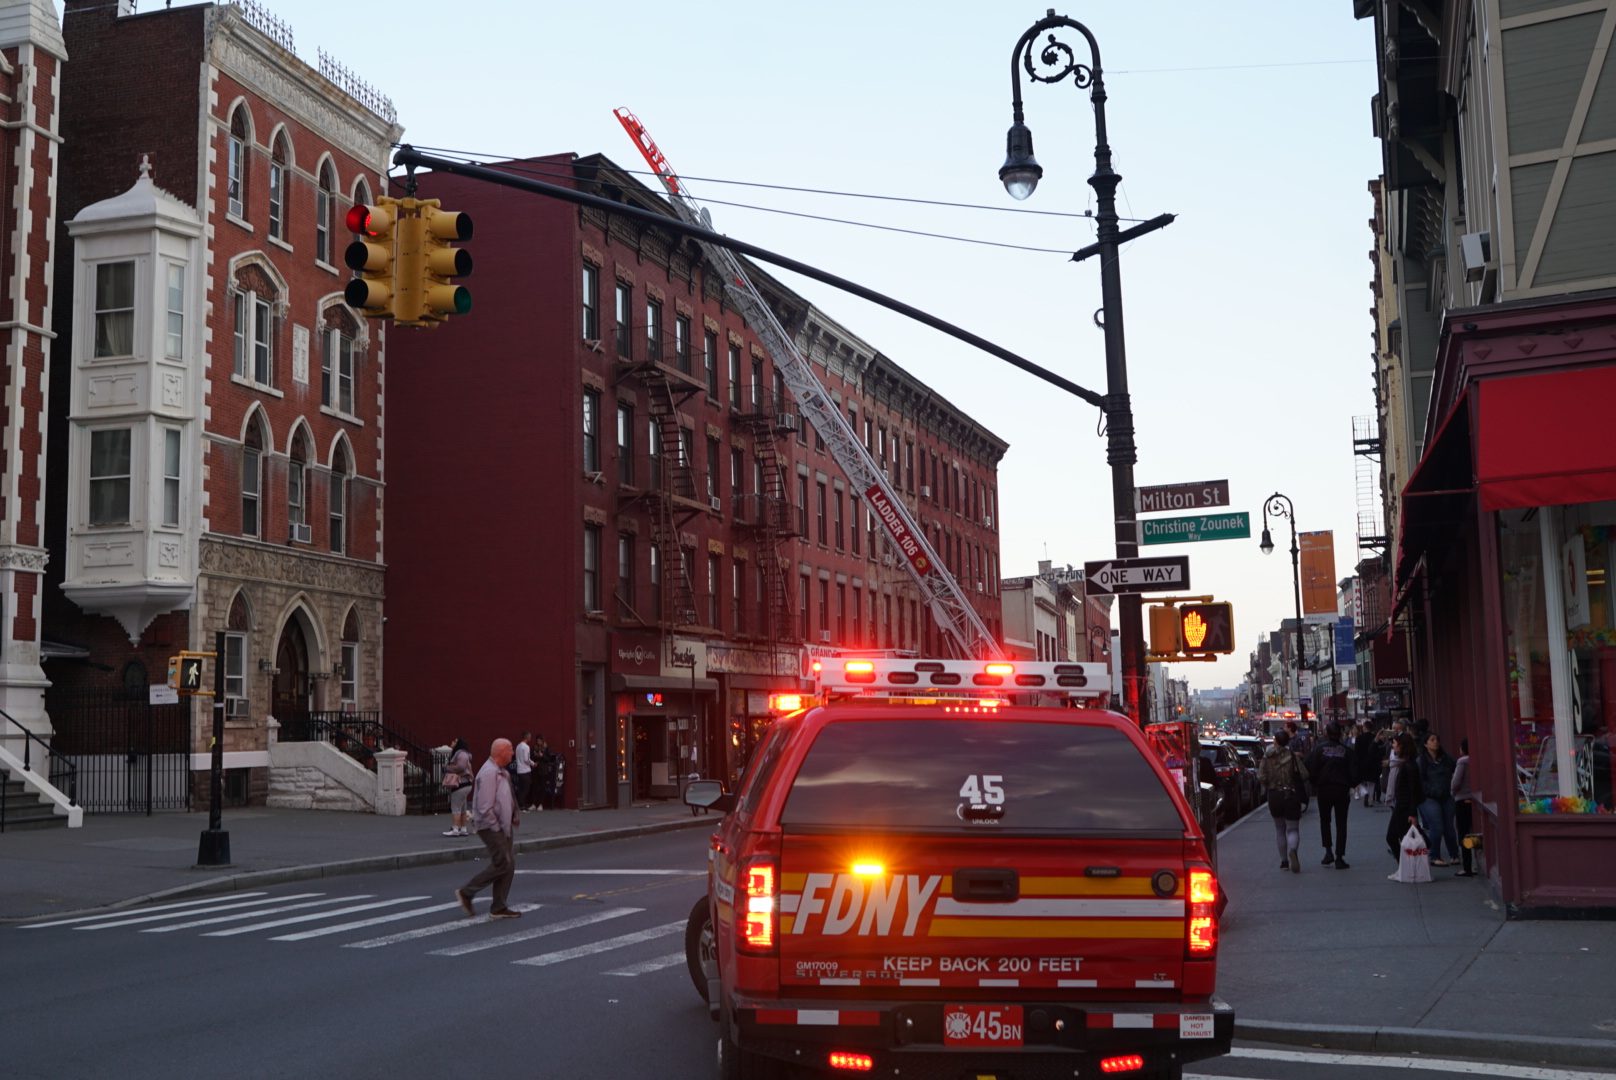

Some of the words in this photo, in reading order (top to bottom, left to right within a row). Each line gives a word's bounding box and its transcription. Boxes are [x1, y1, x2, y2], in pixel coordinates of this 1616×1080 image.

[1141, 491, 1195, 511] Milton
[1202, 487, 1220, 505] St
[870, 491, 905, 537] LADDER
[900, 535, 919, 556] 106
[1144, 519, 1195, 535] Christine
[1200, 514, 1245, 531] Zounek
[1187, 532, 1201, 541] Way
[1100, 569, 1128, 584] ONE
[1143, 567, 1175, 582] WAY
[1354, 580, 1362, 625] TRAVEL
[618, 648, 635, 661] Upright
[643, 650, 656, 660] Coffee
[1378, 677, 1409, 685] CHRISTINA'S
[959, 774, 1005, 805] 45
[792, 872, 942, 937] FDNY
[796, 961, 838, 970] GM17009
[883, 956, 932, 972] KEEP
[939, 957, 990, 972] BACK
[998, 957, 1031, 972] 200
[1039, 957, 1084, 972] FEET
[796, 969, 904, 980] SILVERADO
[1153, 973, 1167, 982] LT
